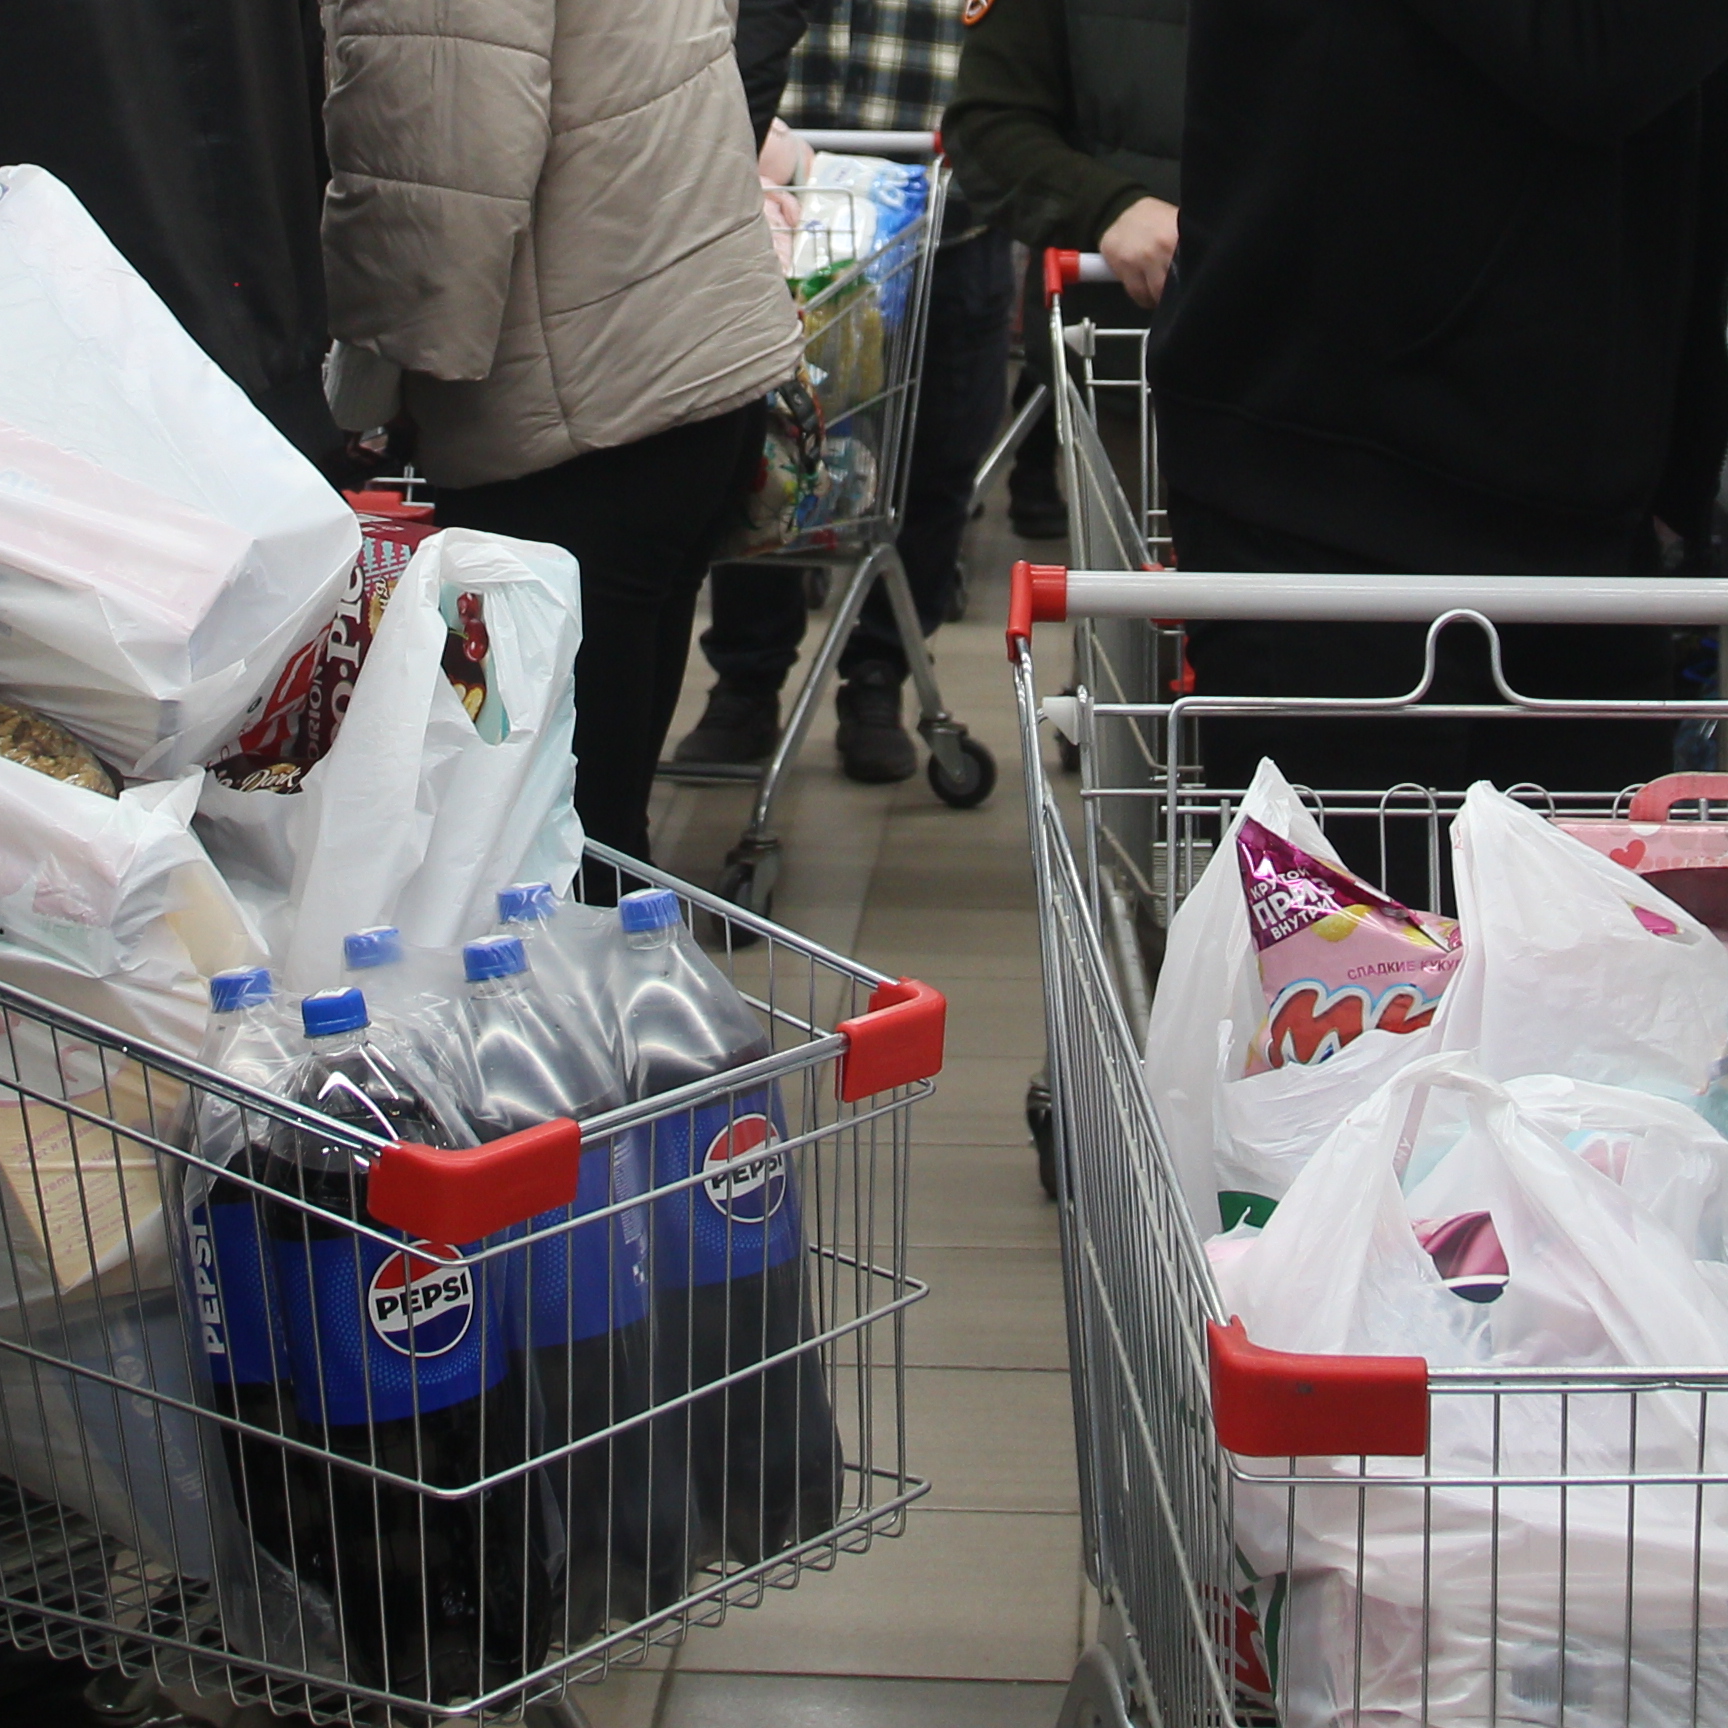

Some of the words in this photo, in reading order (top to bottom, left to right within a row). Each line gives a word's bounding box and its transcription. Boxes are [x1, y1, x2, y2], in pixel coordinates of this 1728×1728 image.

[1250, 864, 1311, 899] КРУТОЙ
[1251, 877, 1337, 932] ПРИЗ
[1347, 960, 1415, 980] СЛАДКИЕ
[190, 1224, 225, 1355] PEPSI
[376, 1272, 469, 1321] PEPSI
